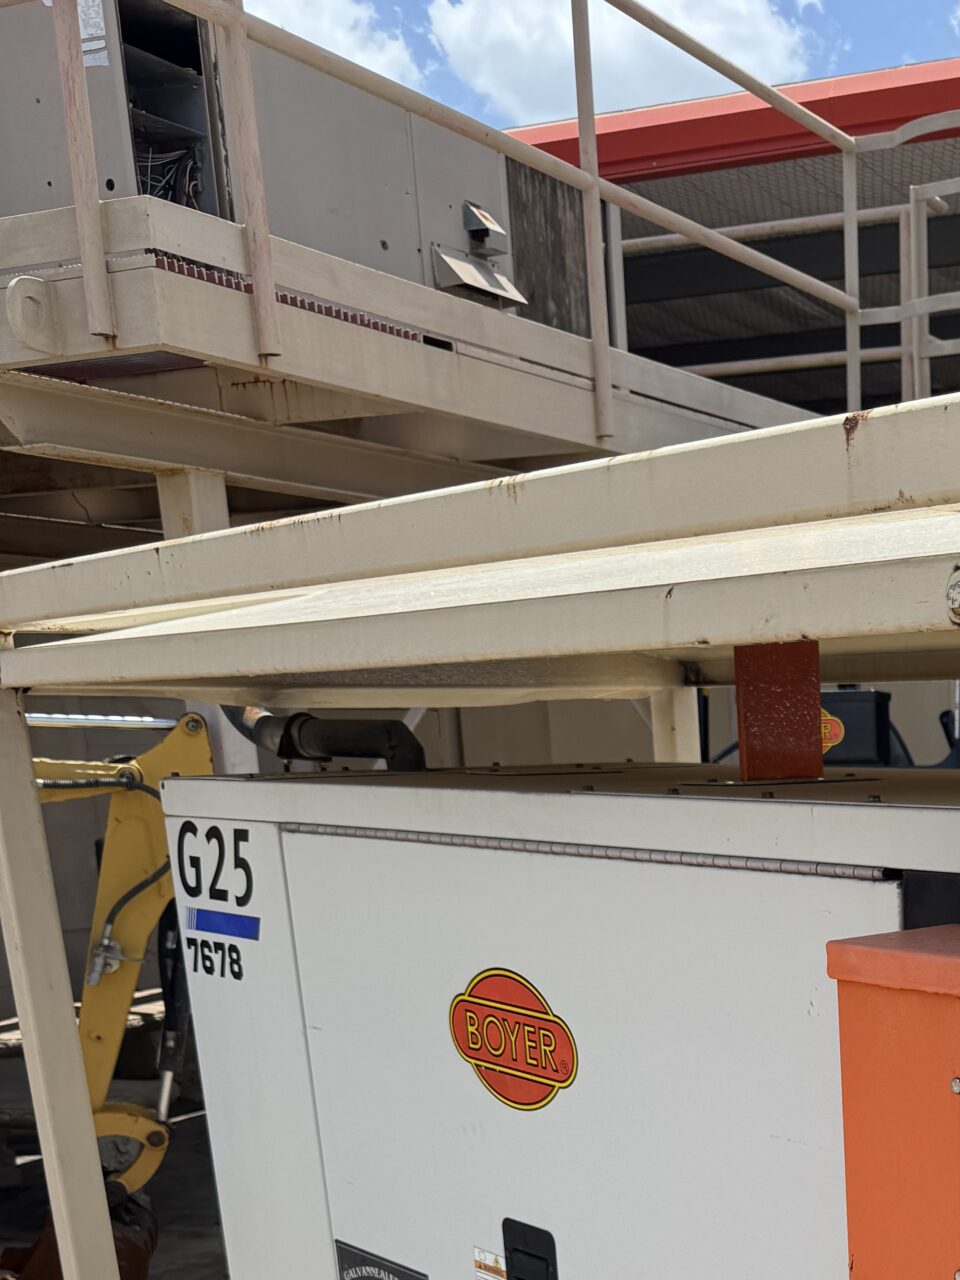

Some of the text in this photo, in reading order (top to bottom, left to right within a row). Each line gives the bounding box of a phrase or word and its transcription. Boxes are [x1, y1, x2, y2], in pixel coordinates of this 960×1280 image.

[178, 820, 254, 908] G25
[186, 937, 244, 981] 7678
[465, 1009, 559, 1073] BOYER
